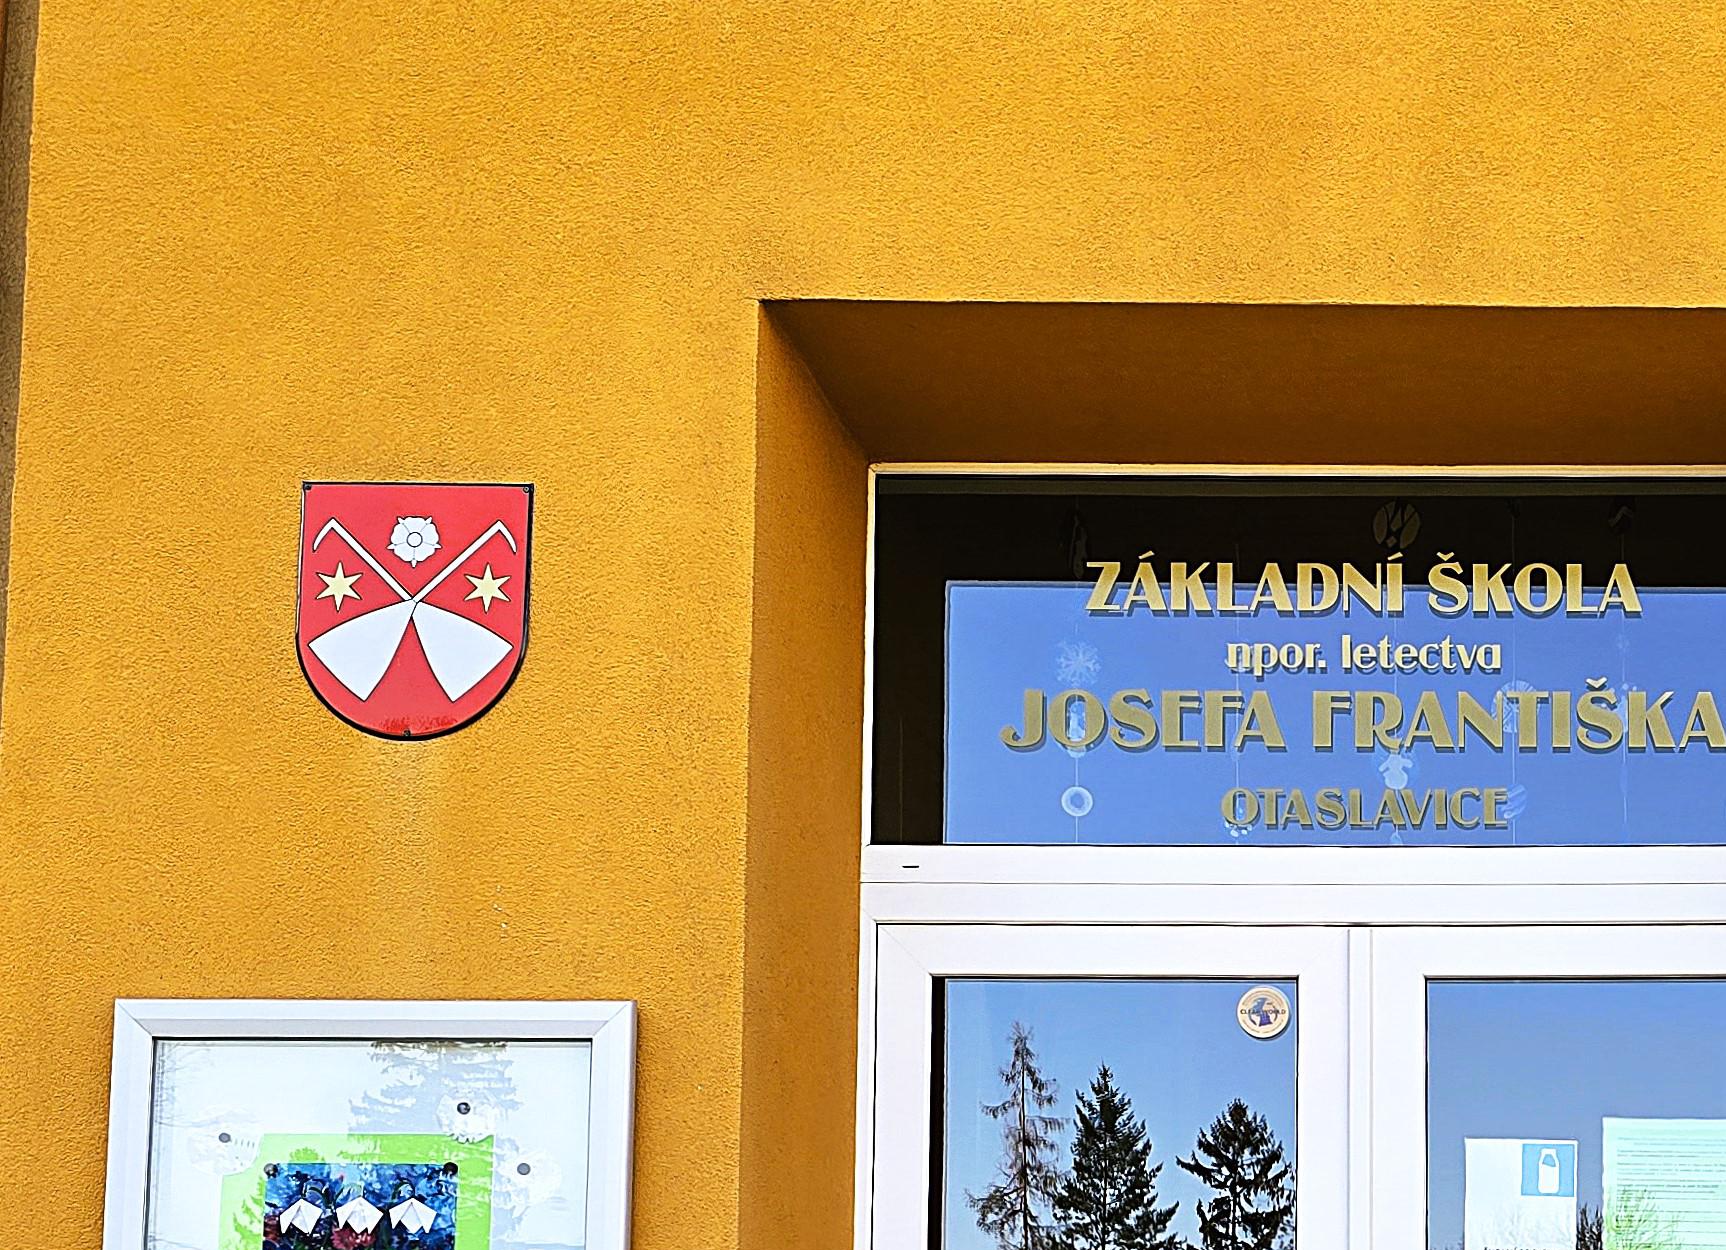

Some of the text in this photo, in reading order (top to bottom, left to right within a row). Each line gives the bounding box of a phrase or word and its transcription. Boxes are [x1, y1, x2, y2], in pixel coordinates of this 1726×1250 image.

[1085, 552, 1643, 615] ZÁKLADNÍ ŠKOLA
[1226, 633, 1502, 679] npor. letectva
[1000, 690, 1286, 751] JOSEFA
[1221, 786, 1509, 831] OTASLAVICE
